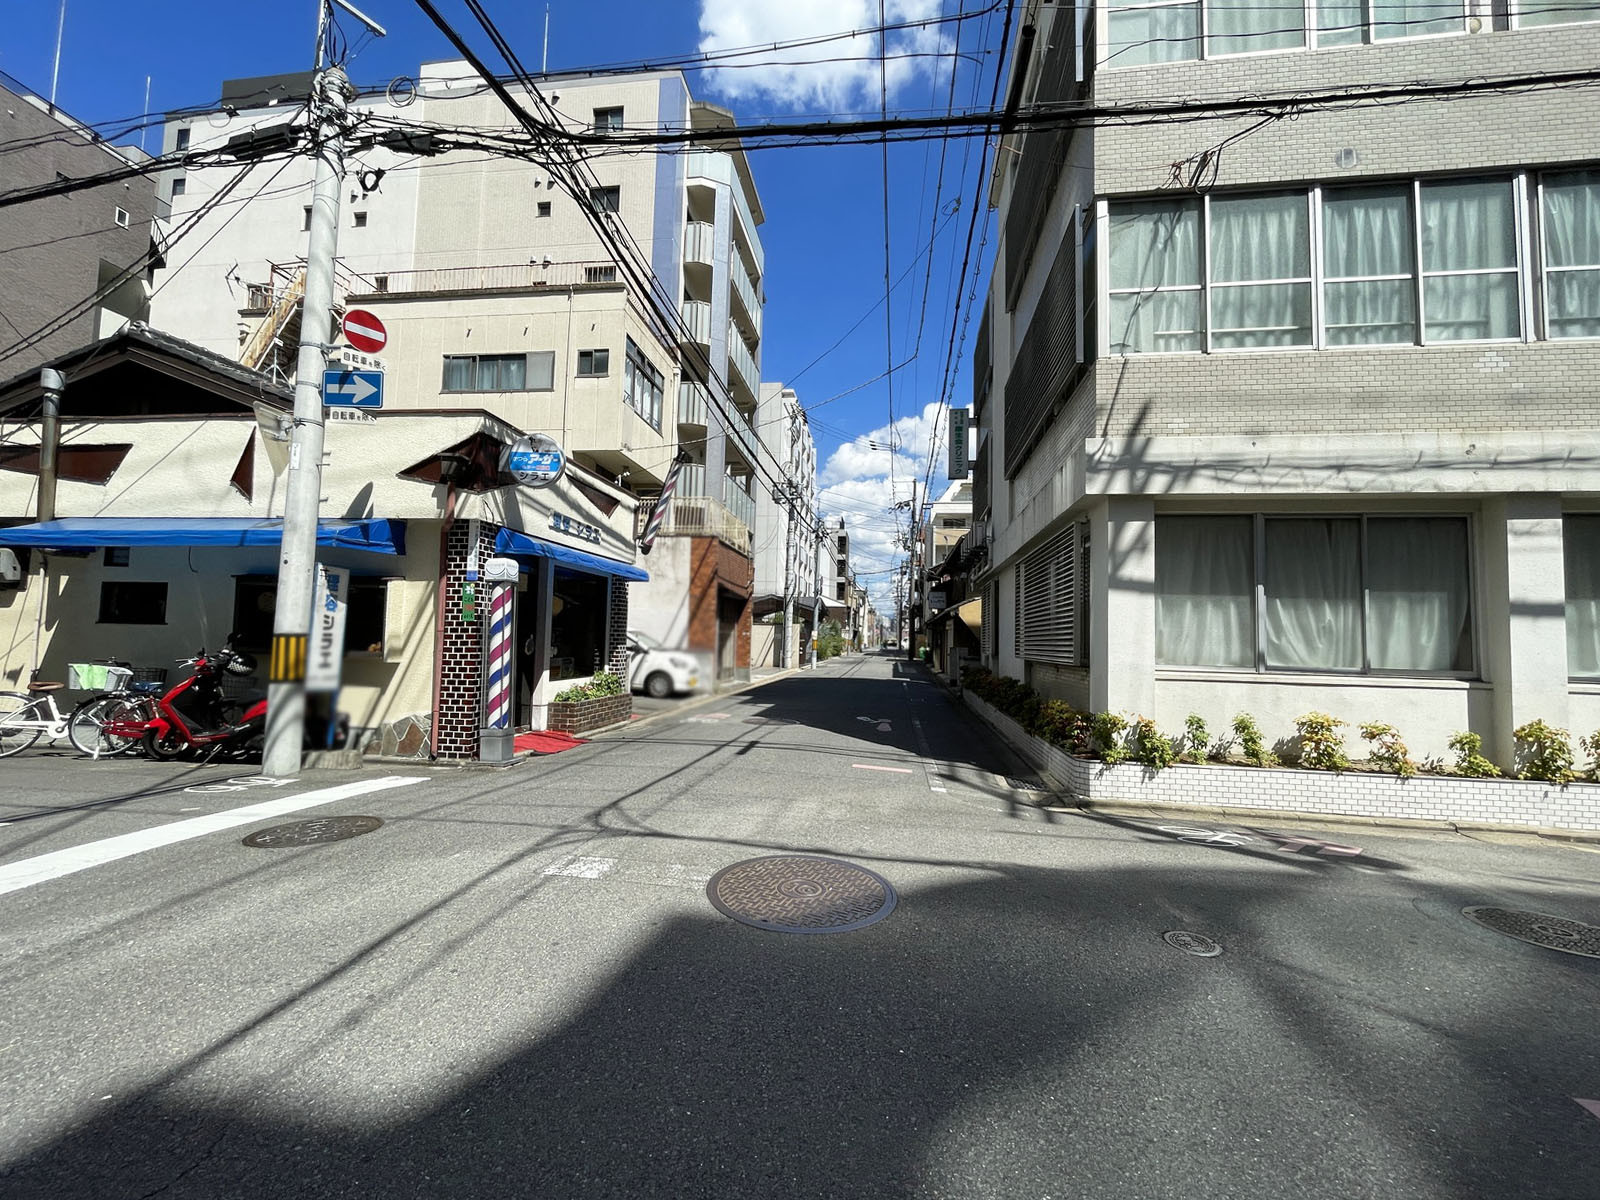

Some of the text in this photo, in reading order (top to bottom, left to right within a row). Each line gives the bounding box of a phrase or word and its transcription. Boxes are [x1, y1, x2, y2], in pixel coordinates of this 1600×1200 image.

[343, 352, 386, 371] 自転車を除く
[332, 411, 375, 422] 自転車を除く
[519, 471, 550, 481] シラエ
